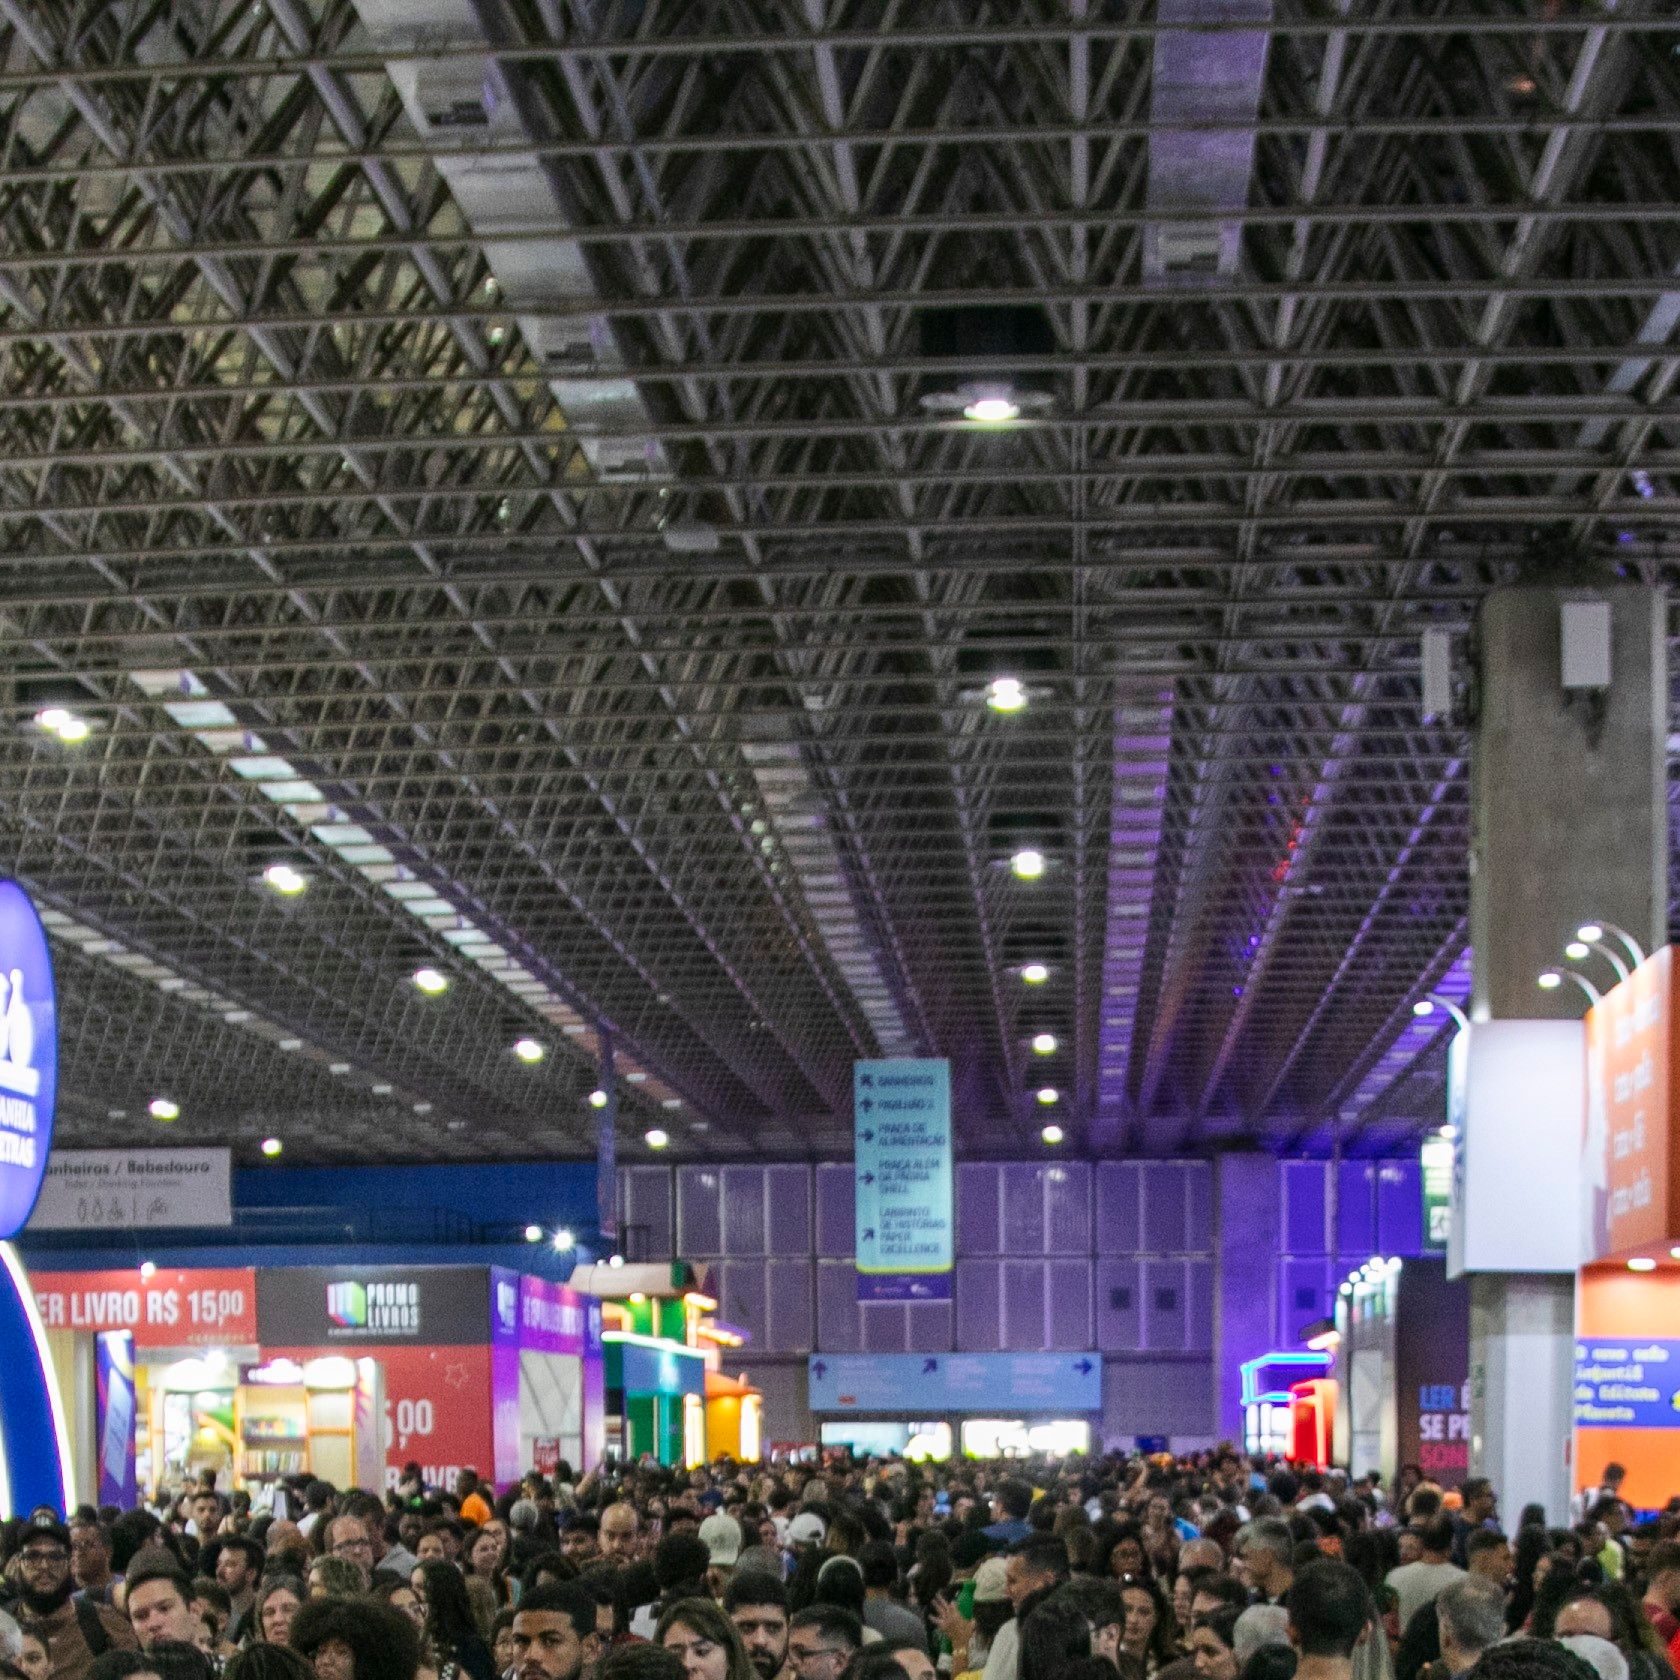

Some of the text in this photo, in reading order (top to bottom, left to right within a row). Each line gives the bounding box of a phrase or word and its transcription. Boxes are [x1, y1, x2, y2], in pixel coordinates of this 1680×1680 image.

[47, 1161, 110, 1176] anheiros
[128, 1159, 210, 1175] Bebedouro
[366, 1284, 418, 1305] PROMO
[71, 1291, 138, 1326] LIVRO
[146, 1290, 178, 1326] R$
[366, 1306, 418, 1328] LIVROS
